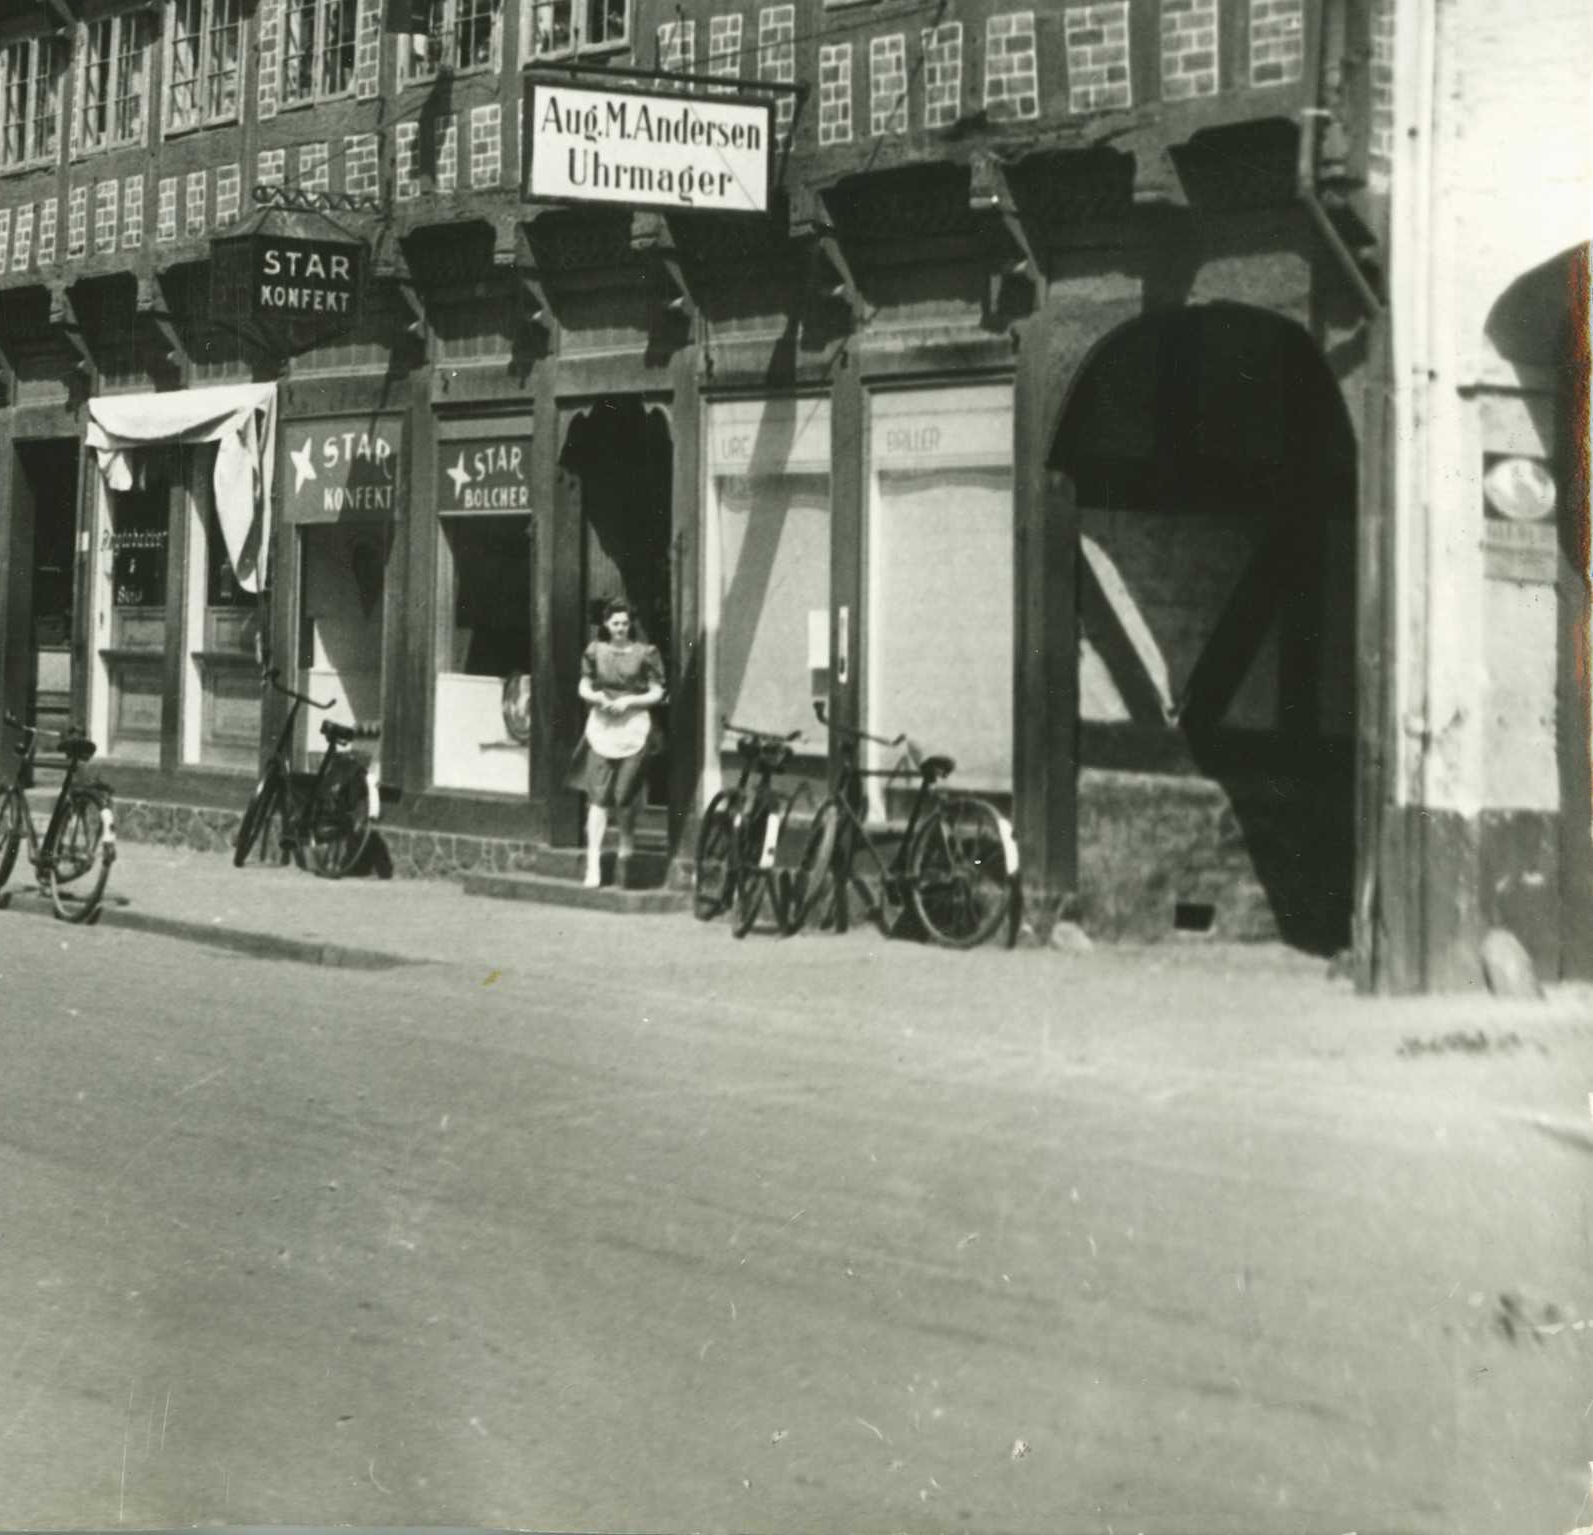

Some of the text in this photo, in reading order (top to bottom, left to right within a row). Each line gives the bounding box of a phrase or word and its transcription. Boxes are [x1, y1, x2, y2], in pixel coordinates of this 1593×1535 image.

[568, 148, 733, 205] Uhrmager
[263, 249, 351, 281] STAR
[260, 284, 351, 313] KONFEKT
[322, 432, 393, 480] STAR
[473, 444, 524, 481] STAR
[323, 485, 394, 512] KONFEKT
